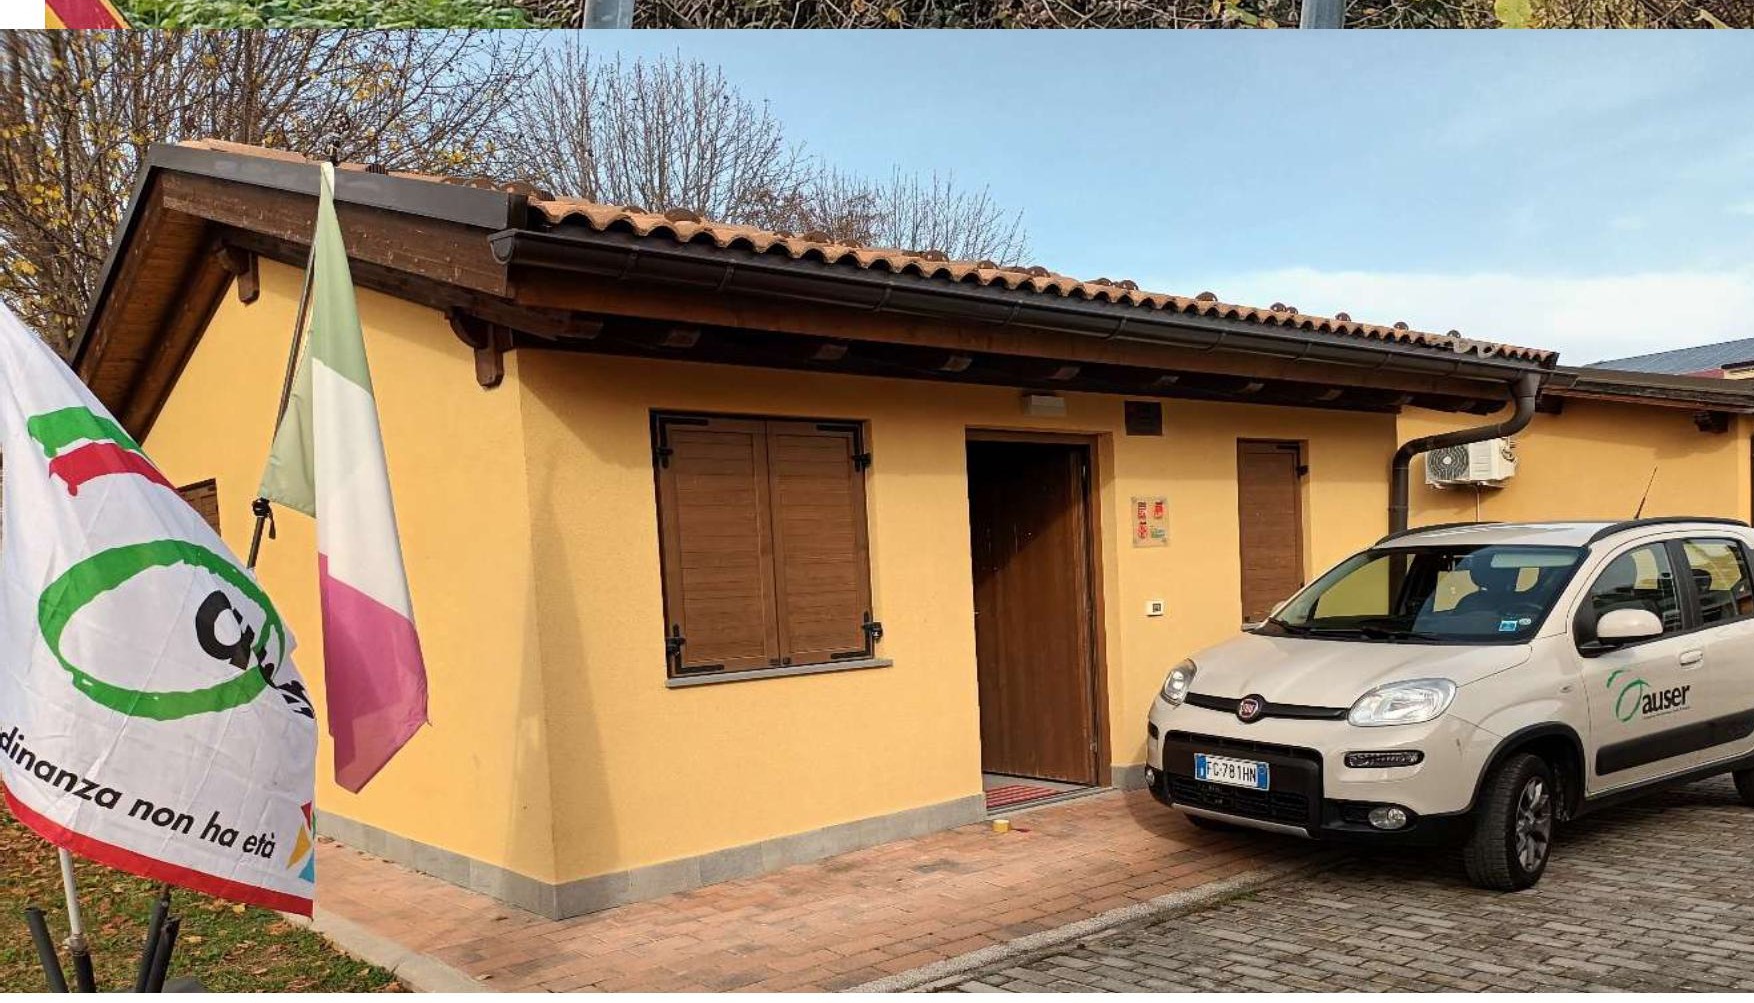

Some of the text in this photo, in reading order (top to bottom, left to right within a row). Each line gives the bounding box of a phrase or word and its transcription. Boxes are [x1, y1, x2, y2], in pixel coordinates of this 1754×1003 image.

[1642, 685, 1691, 715] auser
[128, 798, 195, 835] non
[200, 810, 240, 848] ha
[242, 832, 276, 859] età
